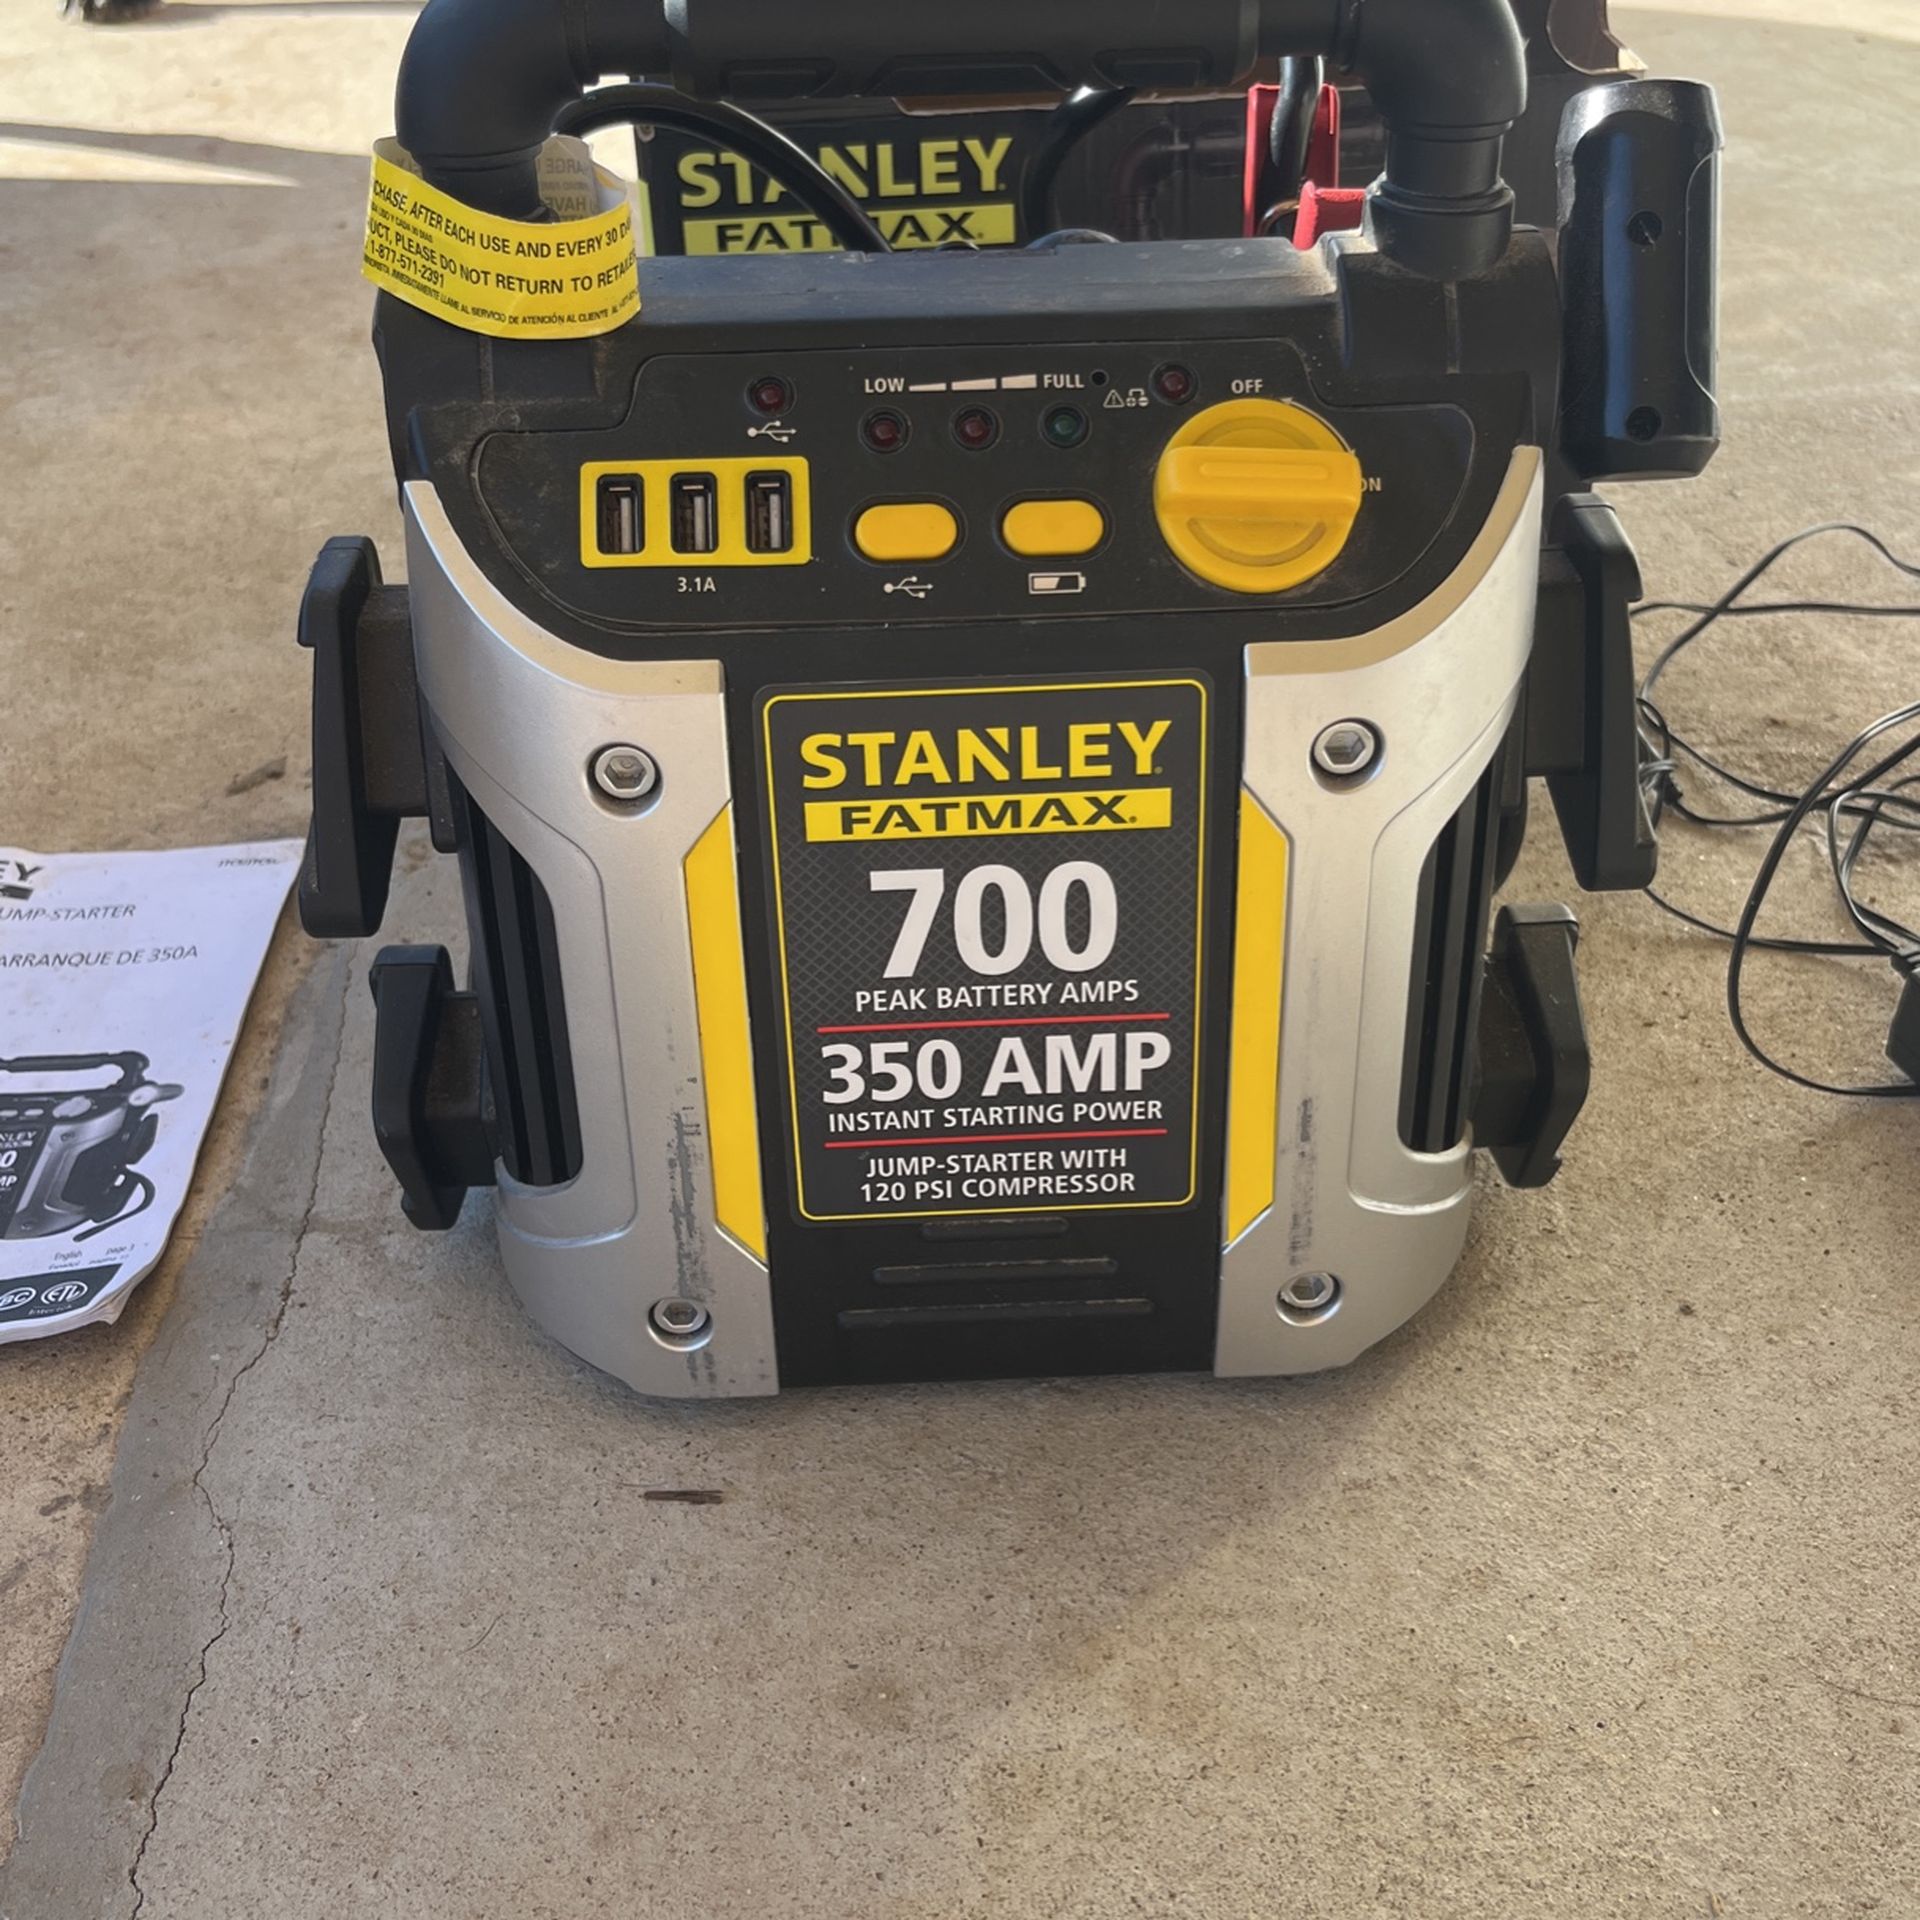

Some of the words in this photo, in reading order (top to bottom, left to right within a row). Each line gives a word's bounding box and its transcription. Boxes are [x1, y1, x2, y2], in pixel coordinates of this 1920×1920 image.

[678, 137, 1013, 208] STNLEY
[373, 180, 408, 214] CHASE,
[410, 201, 443, 231] AFTER
[444, 218, 476, 246] EACH
[480, 233, 511, 254] USE
[515, 241, 552, 258] AND
[556, 234, 603, 258] EVERY
[605, 227, 618, 247] 30
[716, 212, 974, 252] FATAX
[370, 240, 444, 288] 1-877-571-2391
[395, 231, 438, 266] PLEASE
[440, 254, 457, 275] DO
[460, 263, 491, 286] NOT
[495, 273, 563, 295] RETURN
[571, 275, 593, 292] TO
[508, 315, 519, 325] DE
[566, 314, 577, 324] AL
[865, 377, 905, 394] LOW
[1043, 373, 1085, 389] FULL
[1230, 378, 1264, 394] OFF
[677, 576, 717, 593] 3.1A
[800, 720, 1173, 789] STANLEY
[840, 795, 1128, 835] FATMAX
[869, 861, 1118, 979] 700
[116, 950, 145, 966] DE
[148, 945, 198, 963] 350A
[855, 987, 928, 1012] PEAK
[935, 983, 1053, 1009] BATTERY
[1060, 979, 1140, 1005] AMPS
[820, 1038, 963, 1105] 350
[981, 1031, 1172, 1097] AMP
[828, 1108, 935, 1133] INSTANT
[943, 1103, 1065, 1127] STARTING
[1073, 1099, 1163, 1122] POWER
[866, 1151, 1054, 1178] JUMP-STARTER
[1060, 1148, 1127, 1170] WITH
[860, 1182, 906, 1202] 120
[914, 1179, 953, 1200] PSI
[961, 1172, 1136, 1197] COMPRESSOR
